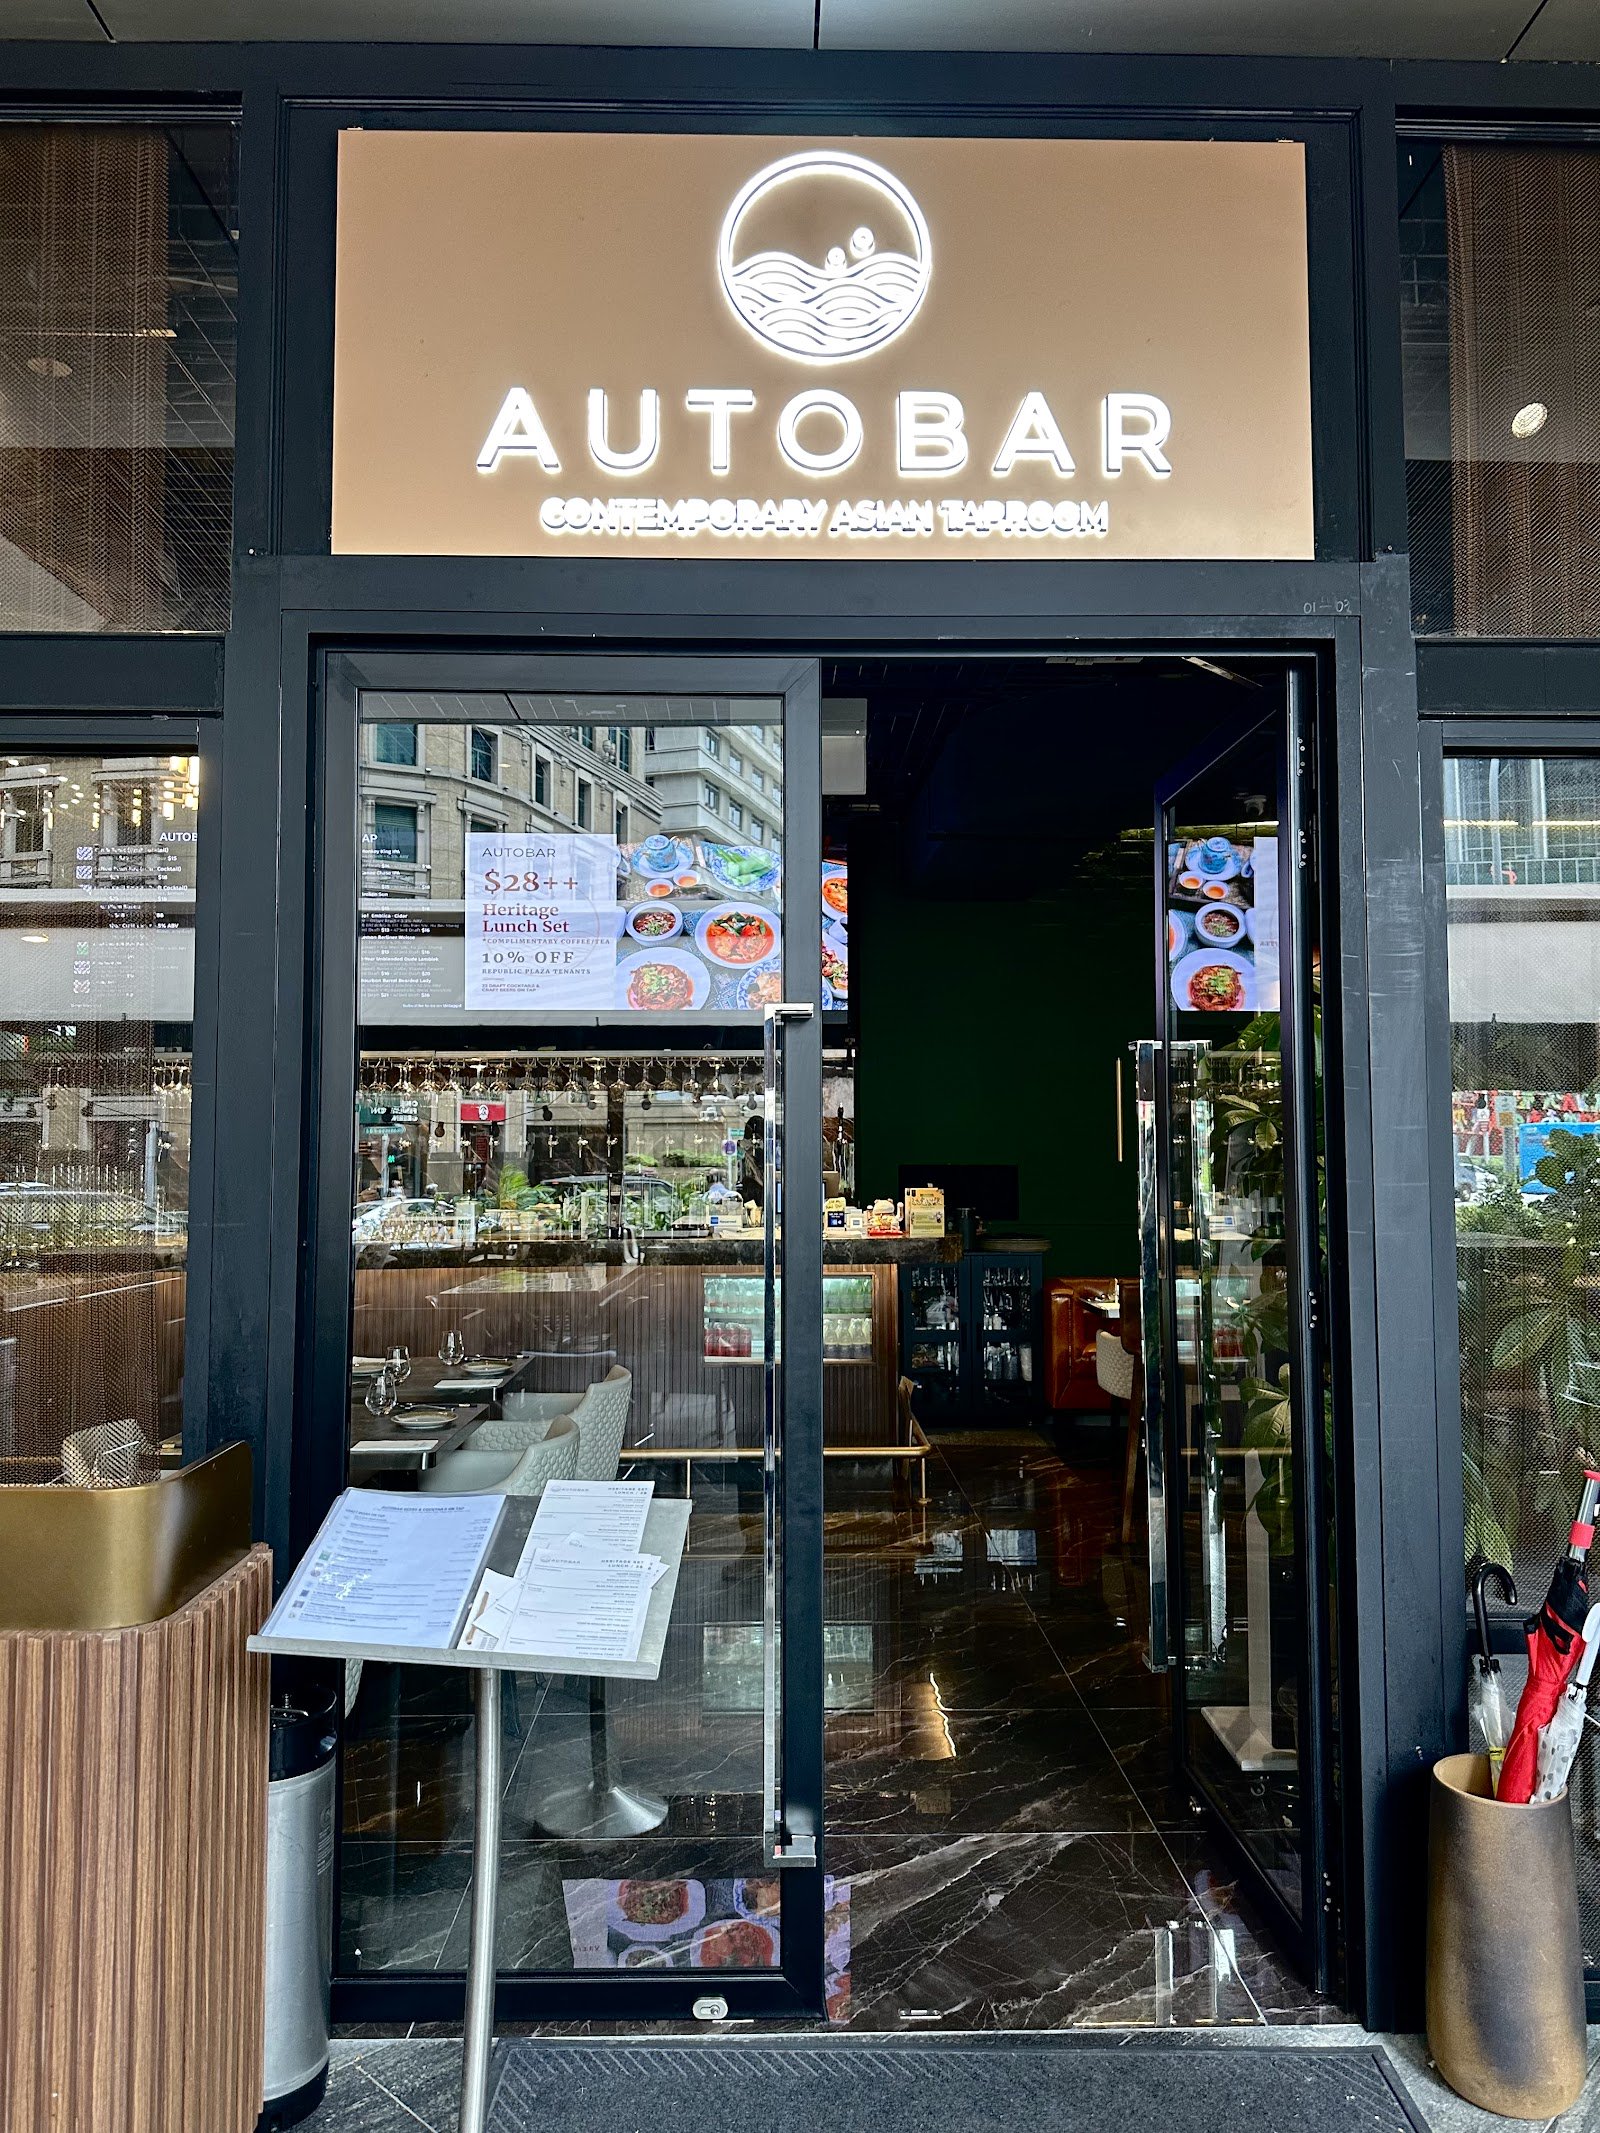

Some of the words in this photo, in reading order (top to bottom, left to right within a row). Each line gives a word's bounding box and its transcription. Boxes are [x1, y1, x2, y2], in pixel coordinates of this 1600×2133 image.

[476, 387, 1174, 475] AUTOBAR
[540, 496, 829, 536] CONTEMPORARY
[828, 499, 934, 537] ASIAN
[937, 499, 1109, 538] TAPROOM
[362, 834, 378, 842] AP
[482, 848, 556, 858] AUTOBAR
[484, 868, 578, 894] $28++
[483, 903, 559, 920] Heritage
[483, 920, 537, 933] Lunch
[542, 920, 570, 933] Set
[482, 951, 525, 963] 10%
[534, 952, 574, 963] OFF
